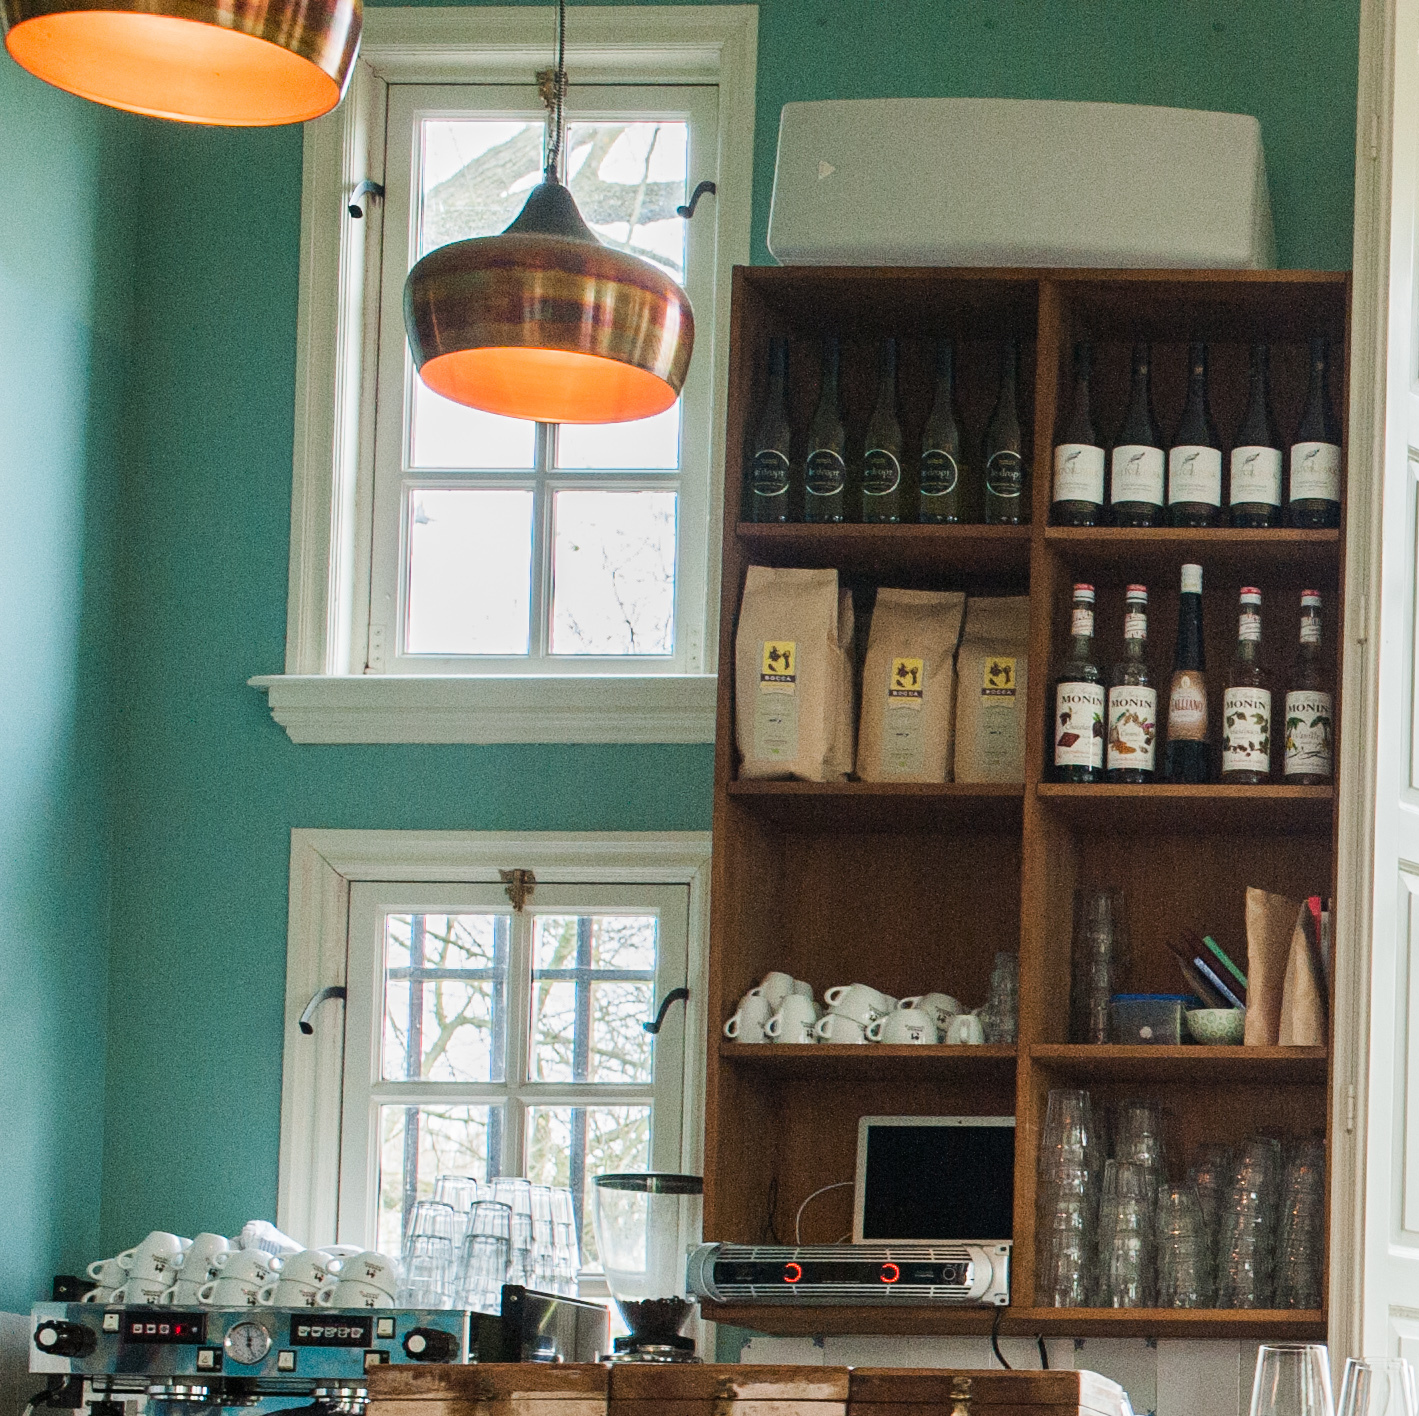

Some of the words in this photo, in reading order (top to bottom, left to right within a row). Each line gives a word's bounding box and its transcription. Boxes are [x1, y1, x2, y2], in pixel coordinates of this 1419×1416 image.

[1062, 695, 1103, 706] MONIN
[1112, 699, 1152, 709] MONIN
[1226, 700, 1266, 710] MONIN
[1288, 703, 1329, 713] MONIN
